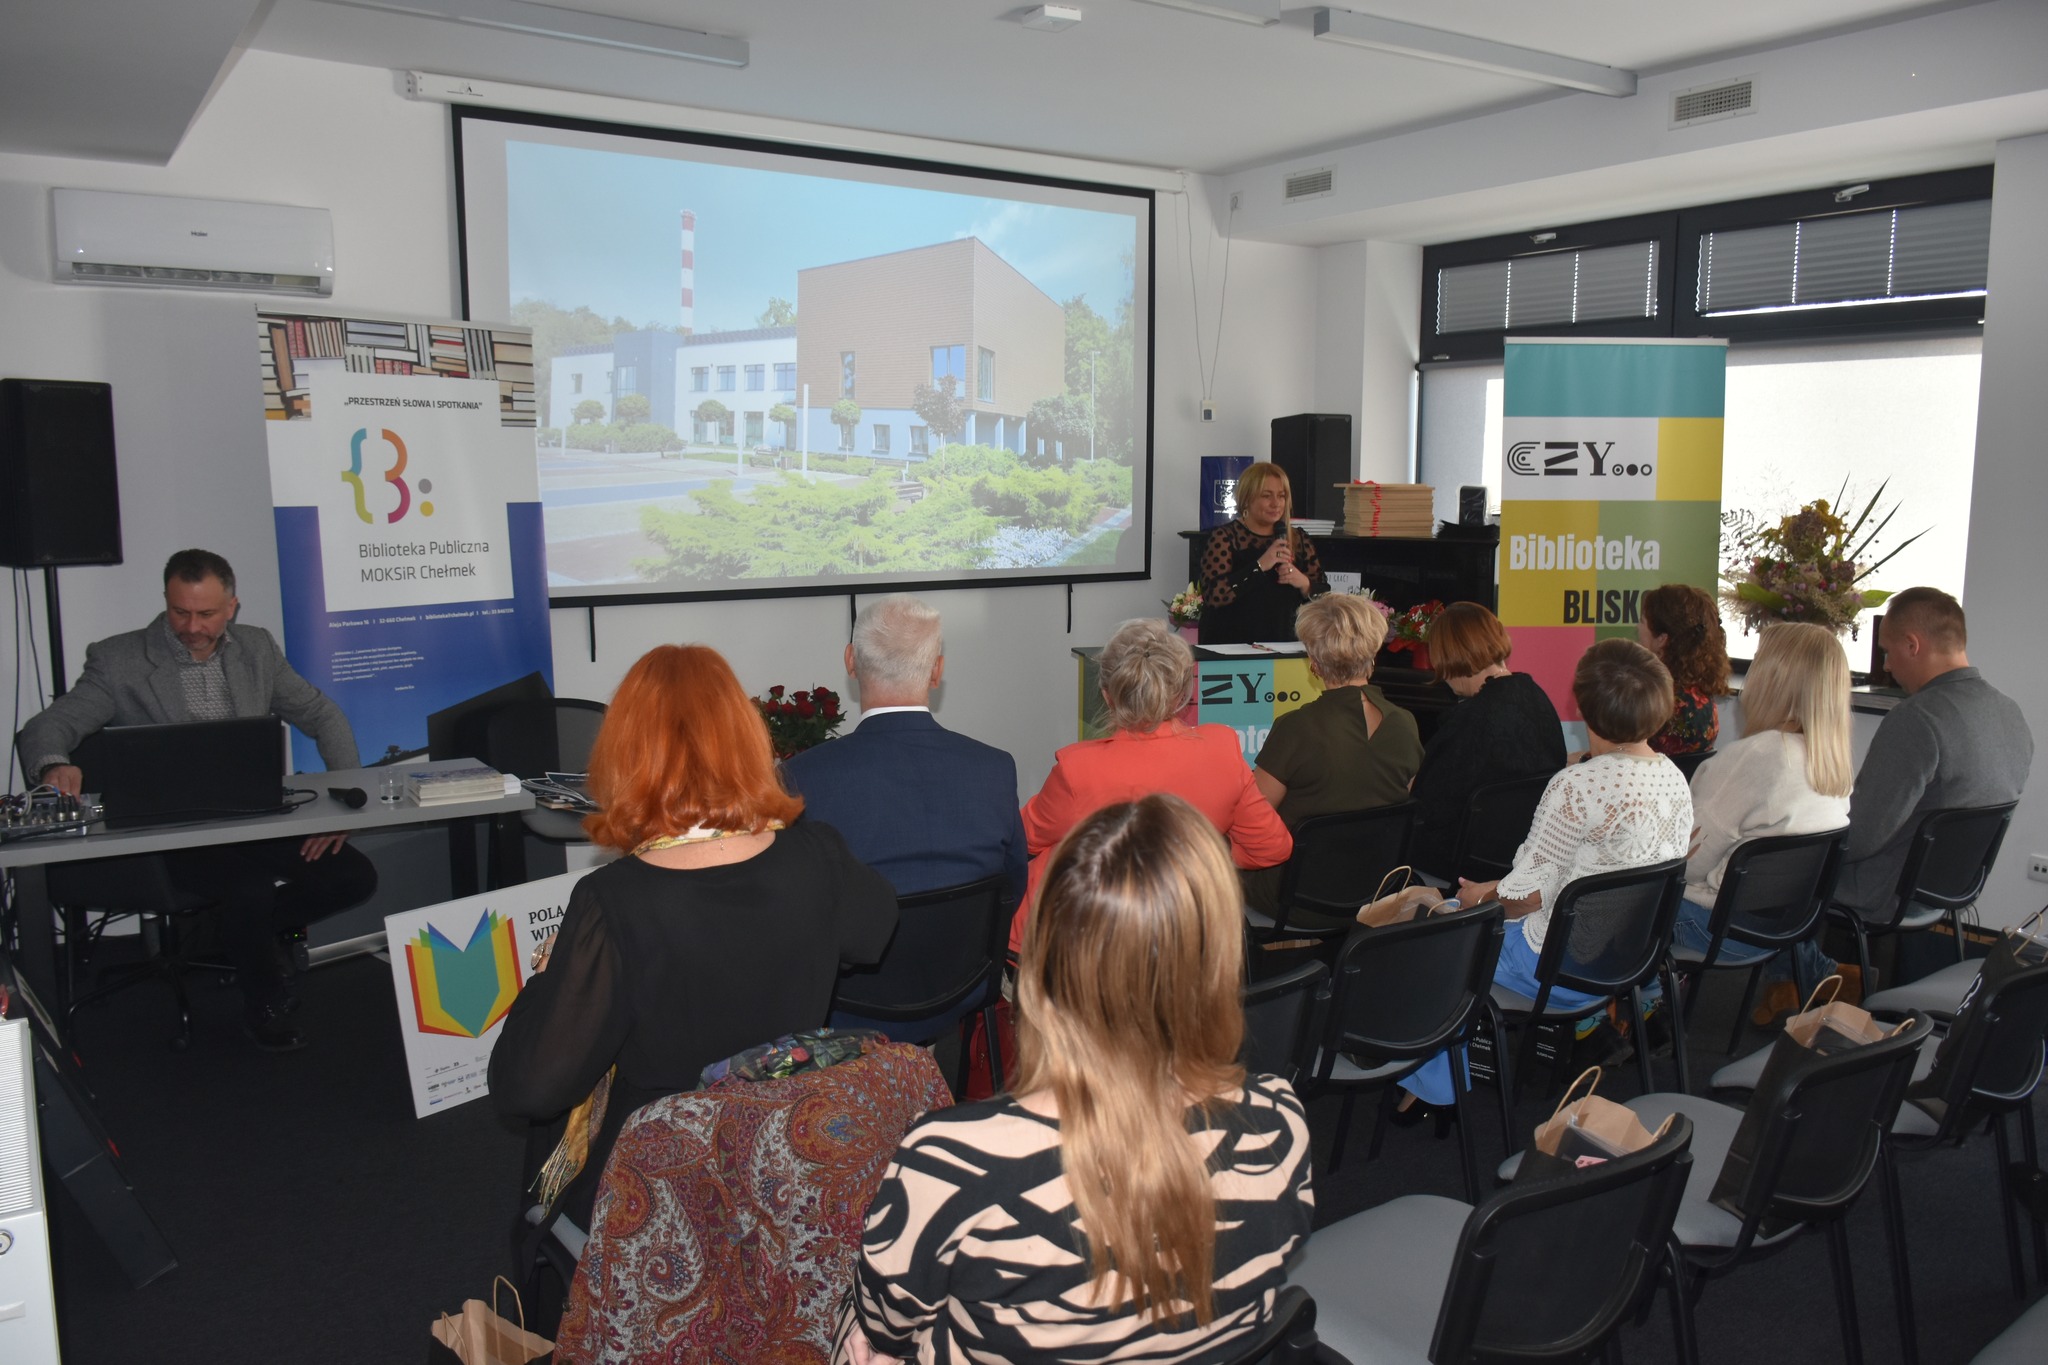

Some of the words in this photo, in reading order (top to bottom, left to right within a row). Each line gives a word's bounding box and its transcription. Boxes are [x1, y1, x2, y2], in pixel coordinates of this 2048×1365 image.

[403, 399, 431, 408] SŁOWA
[359, 542, 426, 558] Biblioteka
[430, 540, 489, 554] Publiczna
[1510, 533, 1660, 570] Biblioteka
[361, 566, 416, 582] MOKSiR
[420, 563, 476, 579] Chełmek
[1563, 590, 1646, 624] BLISK
[1190, 673, 1300, 705] ZY...
